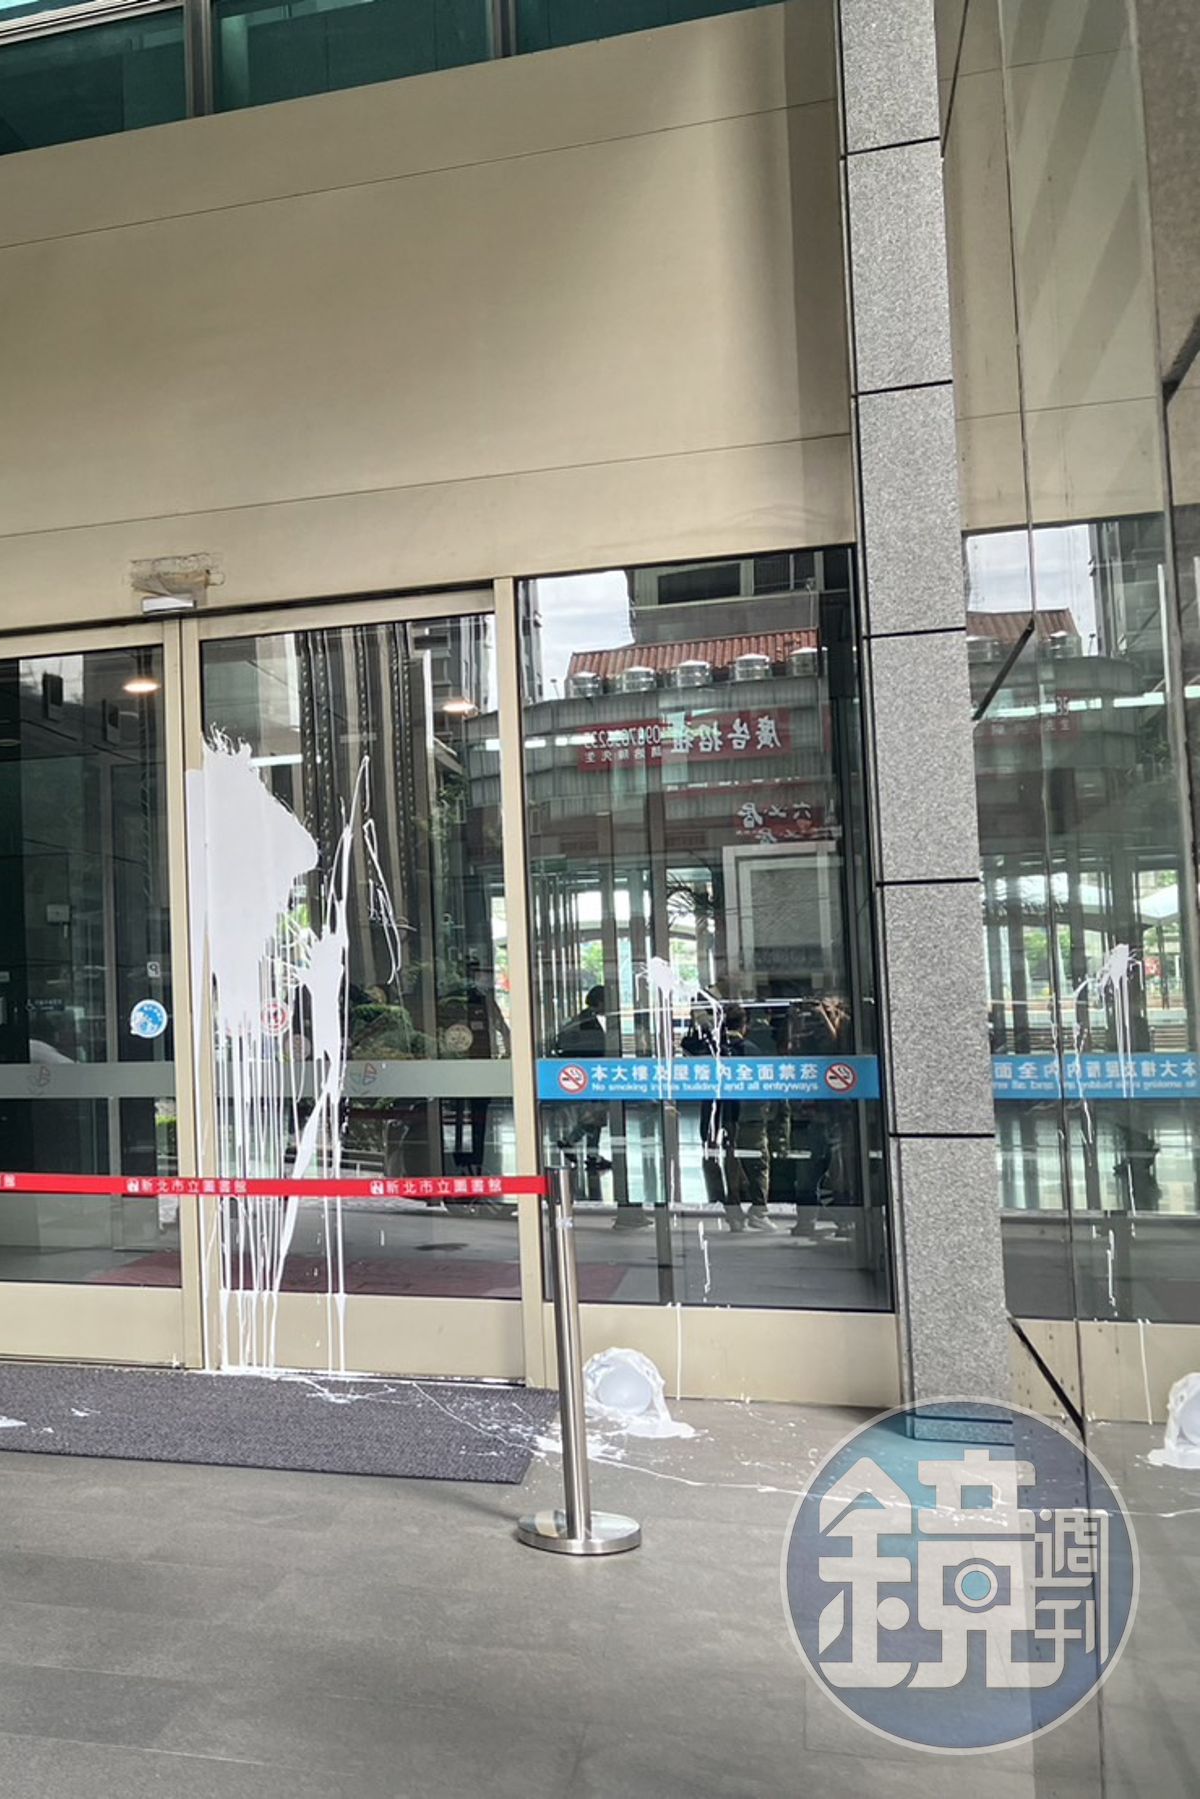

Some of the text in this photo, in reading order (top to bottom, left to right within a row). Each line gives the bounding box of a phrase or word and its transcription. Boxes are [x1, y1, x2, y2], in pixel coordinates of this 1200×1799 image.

[592, 1083, 606, 1092] No
[608, 1083, 648, 1093] smoking
[683, 1082, 720, 1093] building
[724, 1082, 745, 1092] and
[747, 1082, 760, 1092] all
[763, 1082, 819, 1093] entryways
[142, 1178, 247, 1193] 新北市立圖書館
[387, 1178, 502, 1193] 新北市立圖書館
